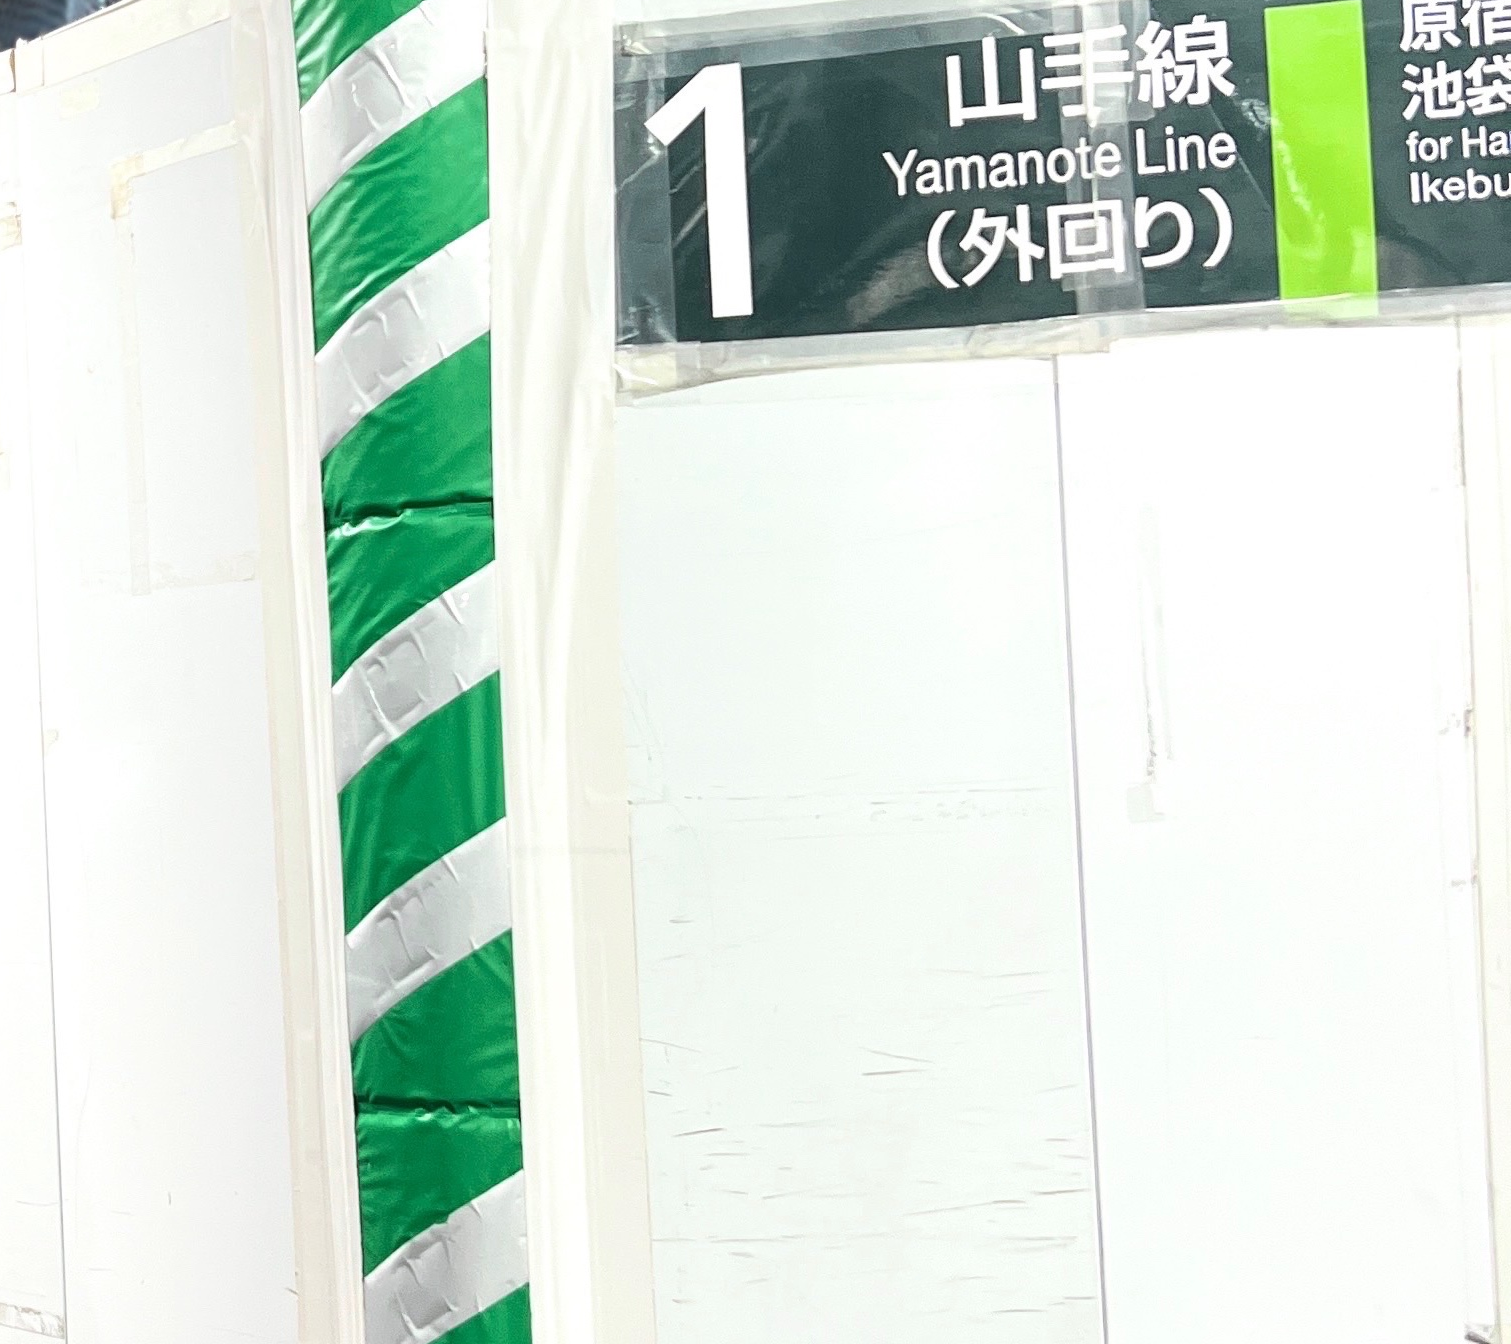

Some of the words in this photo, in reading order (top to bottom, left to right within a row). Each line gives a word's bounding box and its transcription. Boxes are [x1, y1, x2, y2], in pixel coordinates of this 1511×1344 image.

[945, 14, 1236, 127] 山手線
[1402, 54, 1511, 120] 池袋
[883, 137, 1122, 197] Yamanote
[1136, 129, 1237, 175] Line
[1406, 131, 1453, 162] for
[644, 62, 754, 318] 1
[926, 188, 1233, 290] (外回り)
